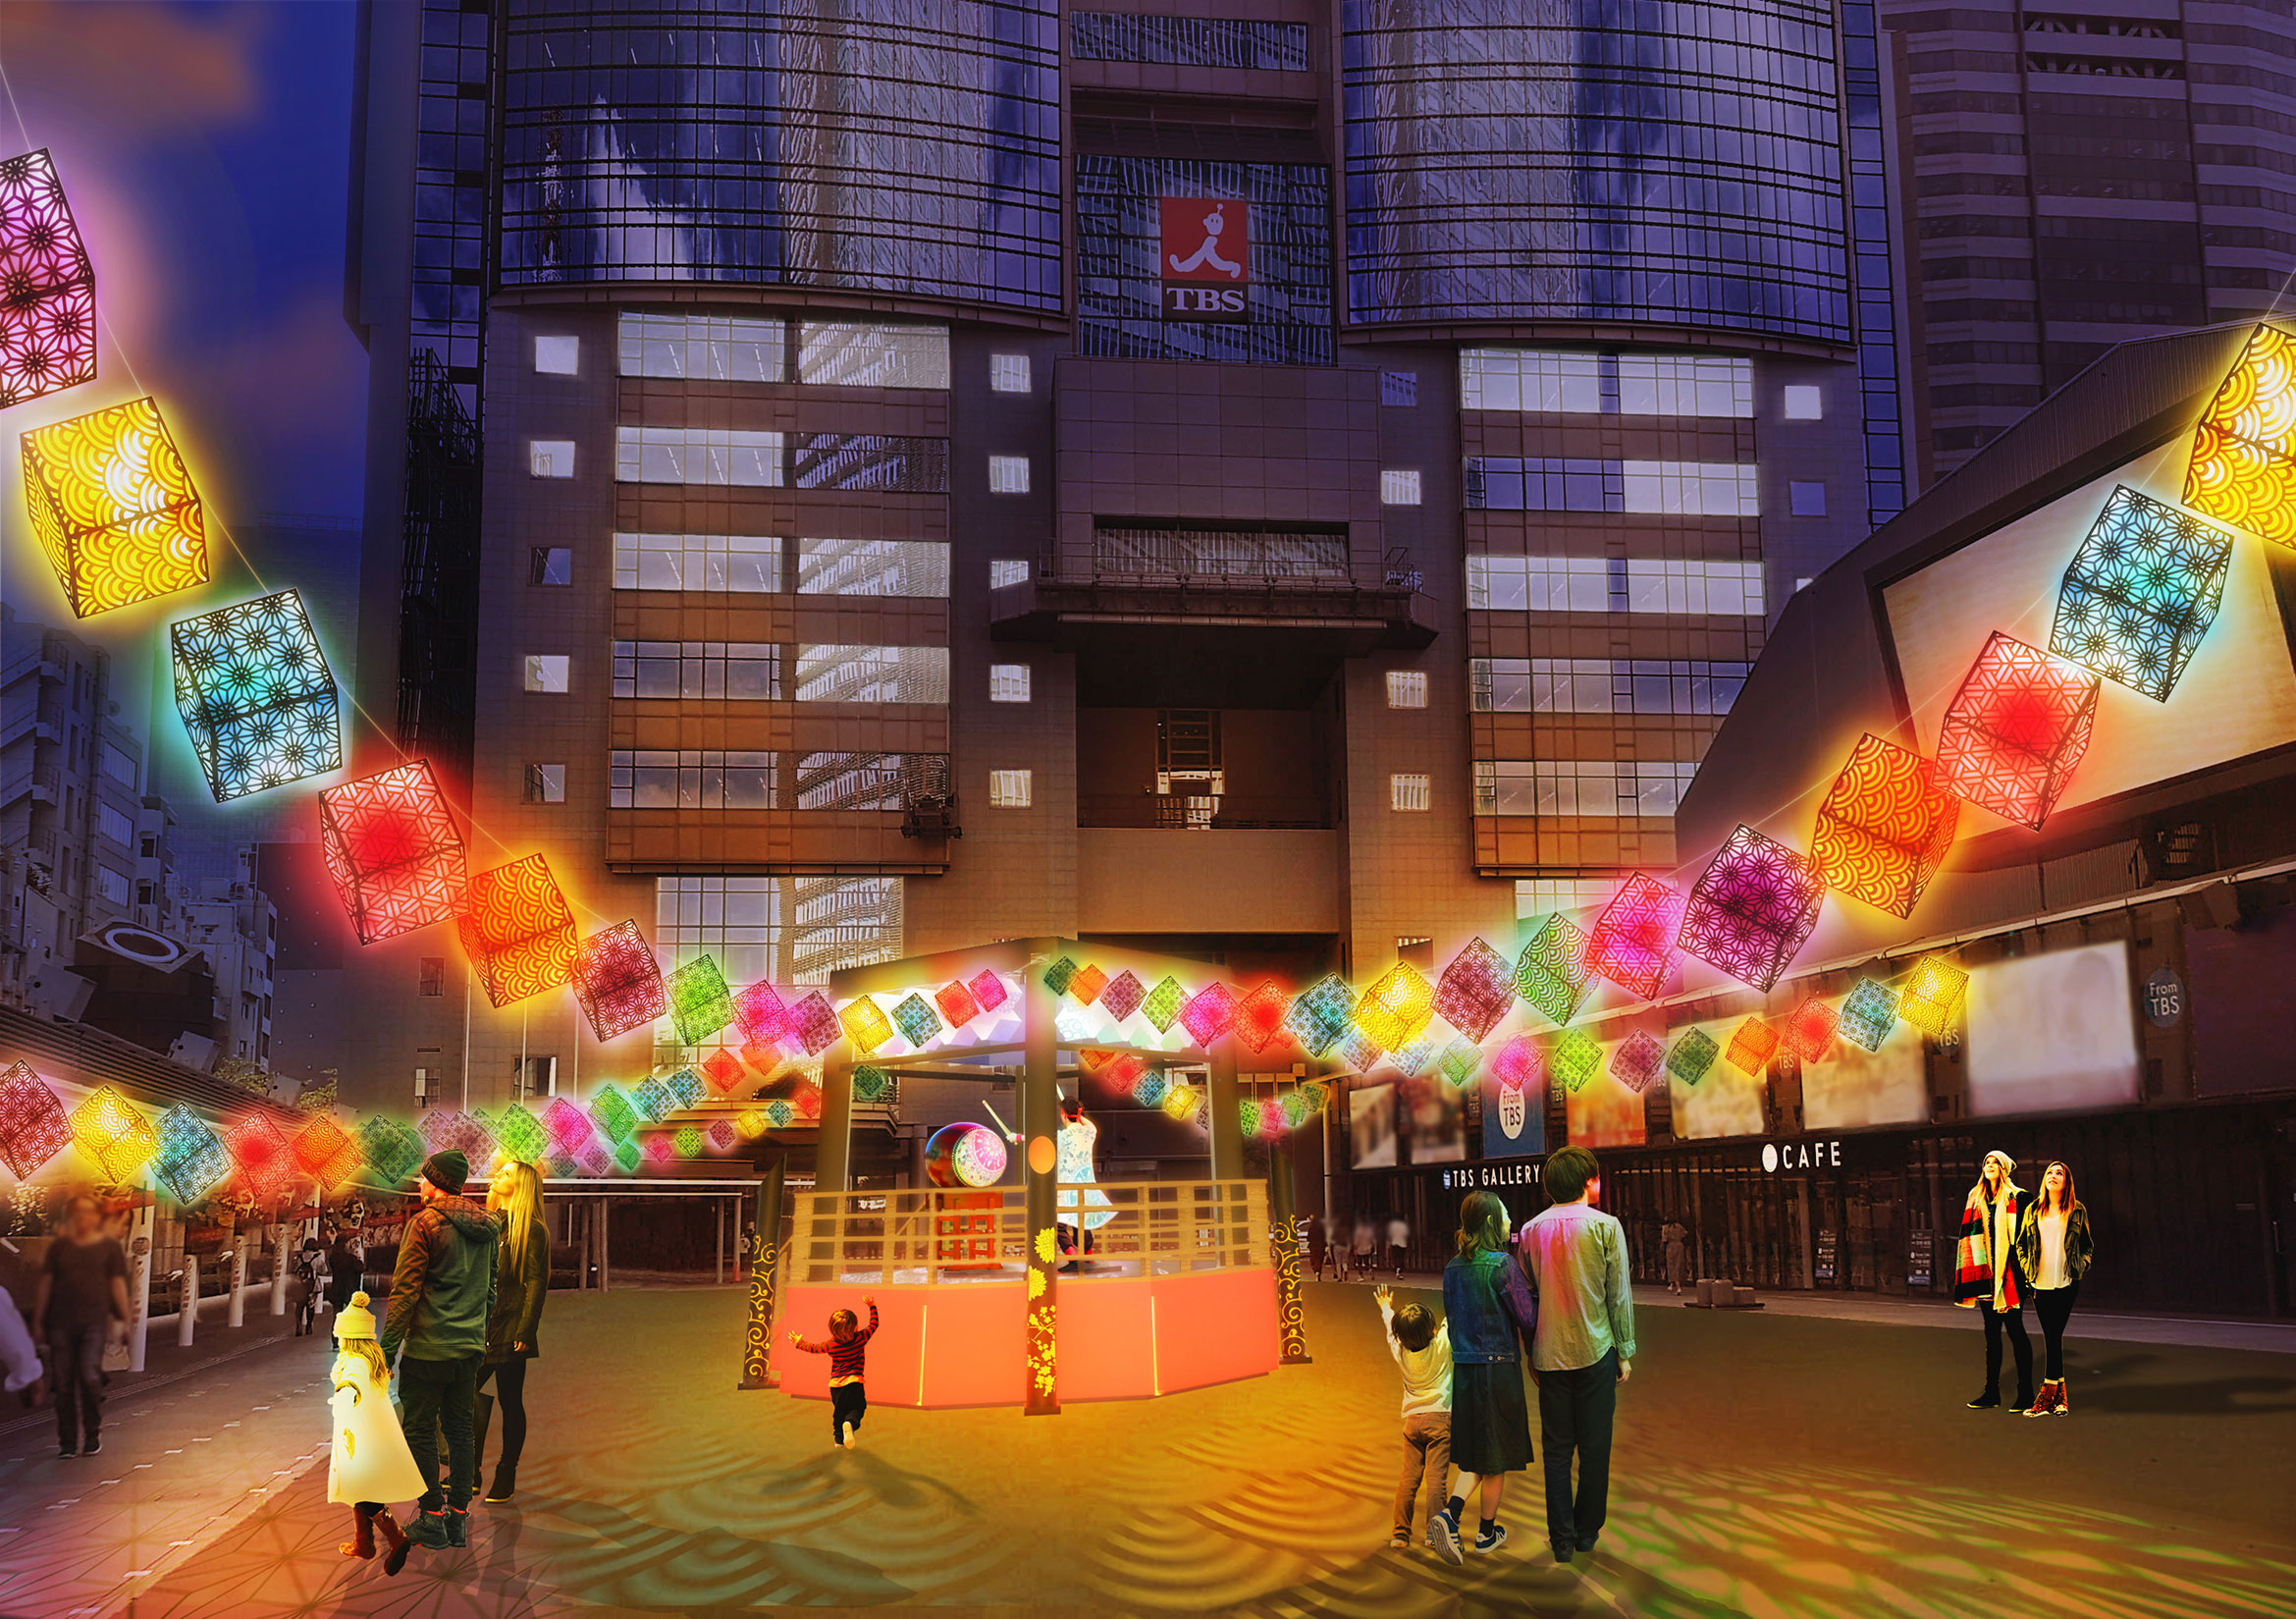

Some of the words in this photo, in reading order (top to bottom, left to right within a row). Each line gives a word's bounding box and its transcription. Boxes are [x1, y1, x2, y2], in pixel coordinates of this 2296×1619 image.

[1166, 288, 1245, 312] TBS
[2150, 983, 2177, 997] From
[2151, 996, 2179, 1016] TBS
[1778, 1053, 1794, 1069] TBS
[1503, 1091, 1521, 1105] From
[1503, 1106, 1521, 1126] TBS
[1783, 1142, 1842, 1169] CAFE
[1453, 1169, 1474, 1188] TBS
[1482, 1164, 1540, 1186] GALLERY
